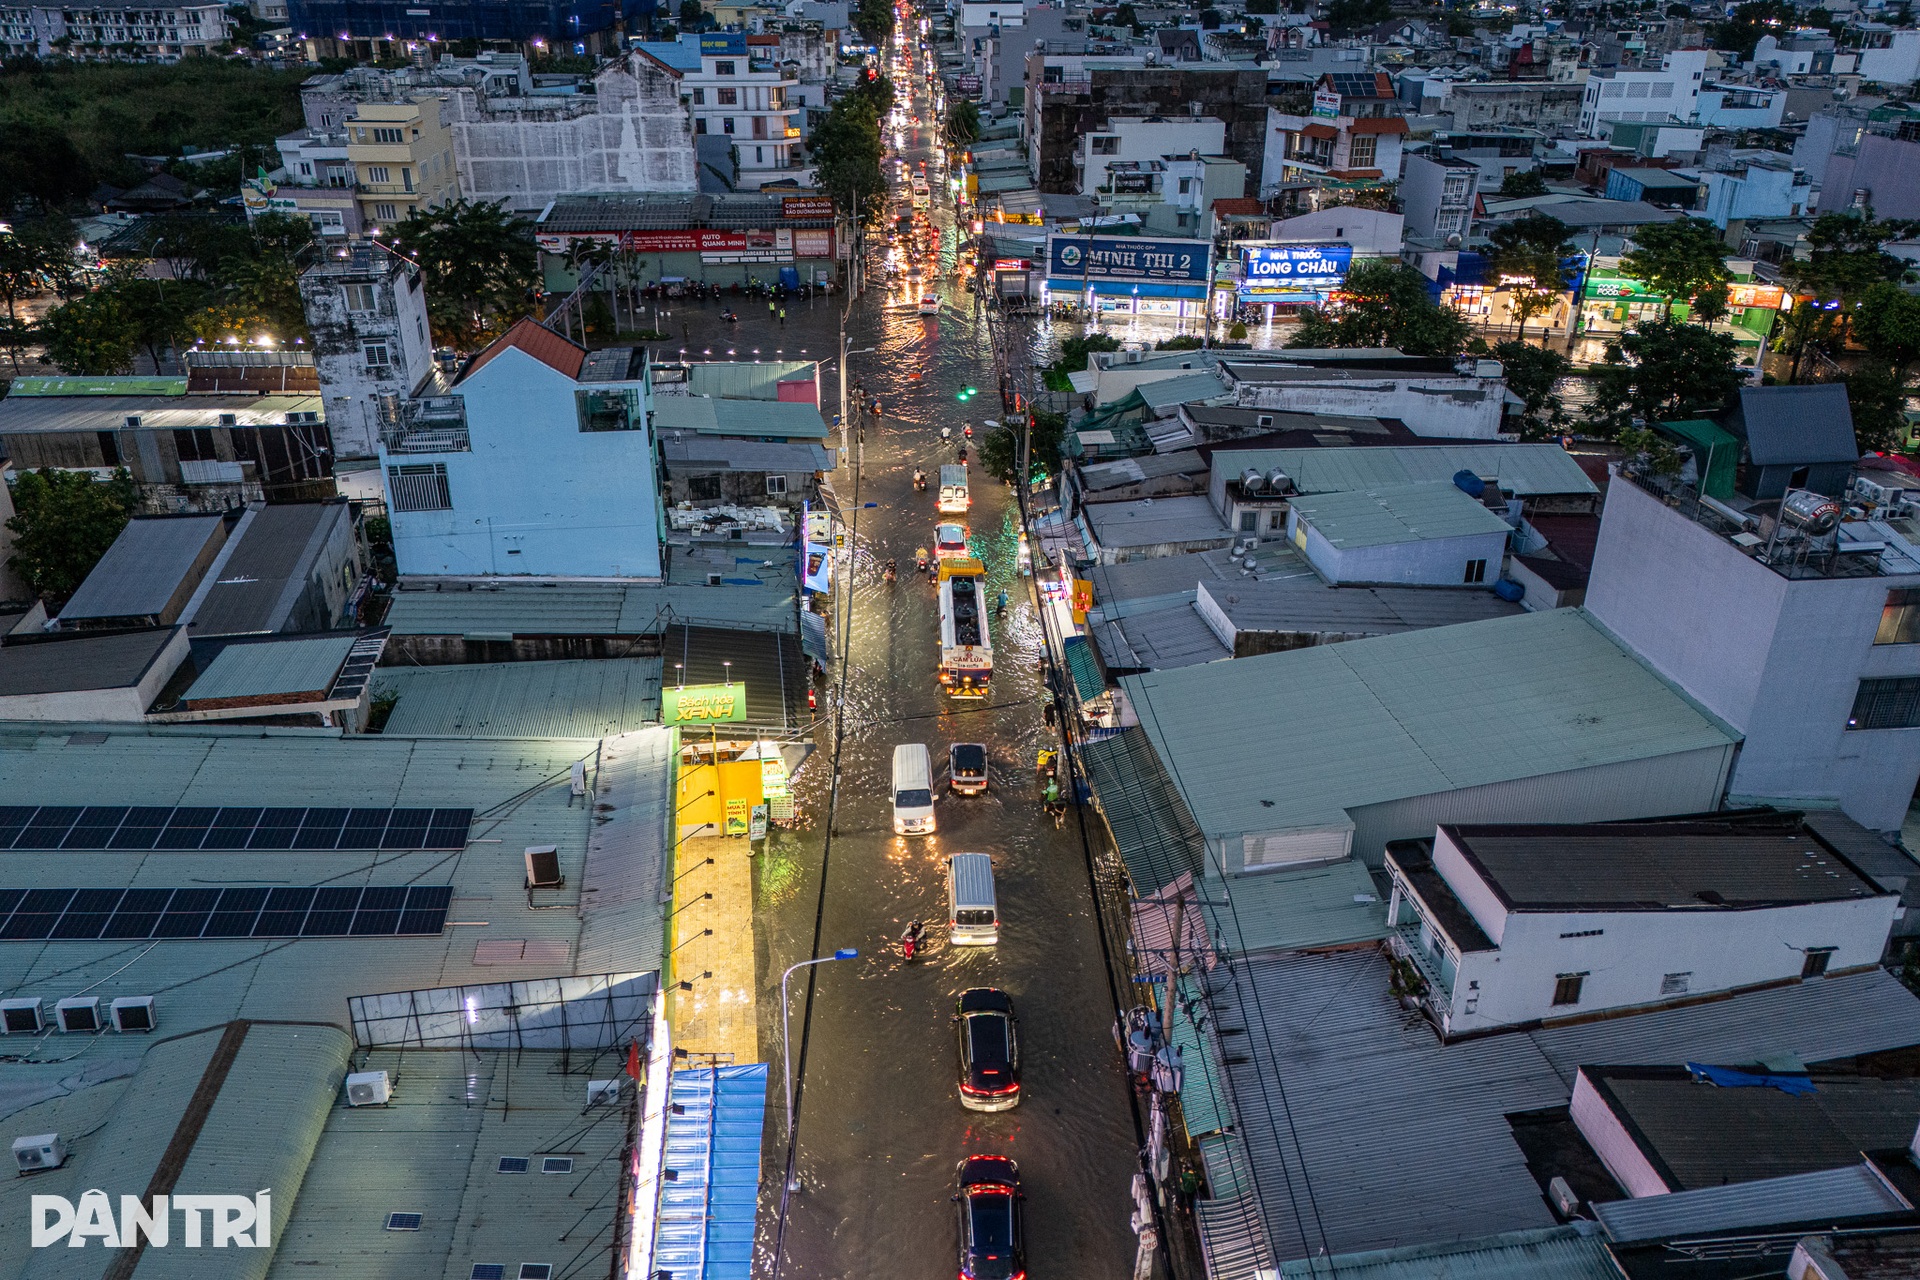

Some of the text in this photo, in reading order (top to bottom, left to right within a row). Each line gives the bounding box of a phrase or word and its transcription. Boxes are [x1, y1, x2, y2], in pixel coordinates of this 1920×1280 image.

[1087, 250, 1191, 269] MINH THI 2
[1270, 249, 1289, 260] NHÀ
[1292, 248, 1322, 260] THUỐC
[1253, 259, 1337, 275] LONG CHÂU
[677, 693, 735, 708] Bách hóa
[675, 705, 734, 721] XANH
